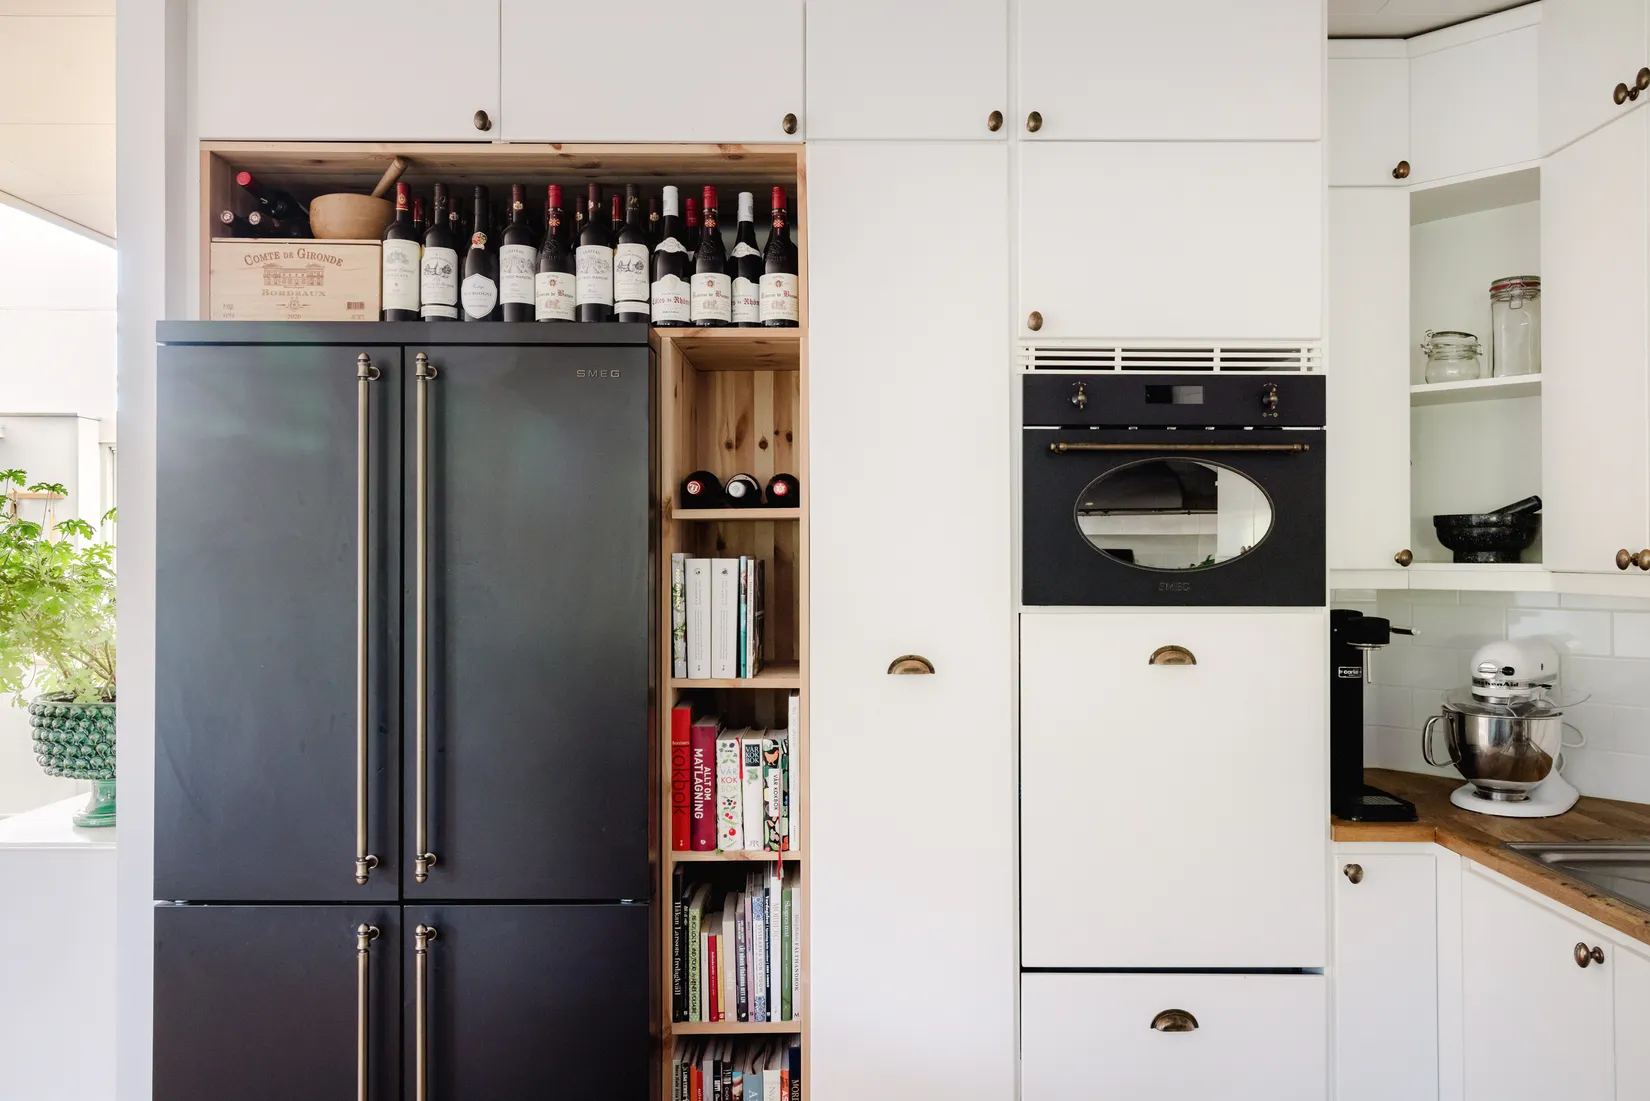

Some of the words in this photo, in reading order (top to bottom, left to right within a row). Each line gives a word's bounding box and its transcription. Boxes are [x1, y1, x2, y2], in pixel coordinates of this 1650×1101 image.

[244, 251, 280, 266] COMTE
[296, 248, 344, 267] GIRONDE
[262, 289, 326, 297] BORDEAUX
[576, 369, 620, 378] SMEG
[1159, 582, 1191, 591] SMEG
[720, 766, 738, 776] VÅR
[672, 746, 690, 816] kokbok
[694, 748, 704, 820] MATLAGNING
[704, 787, 712, 800] OM
